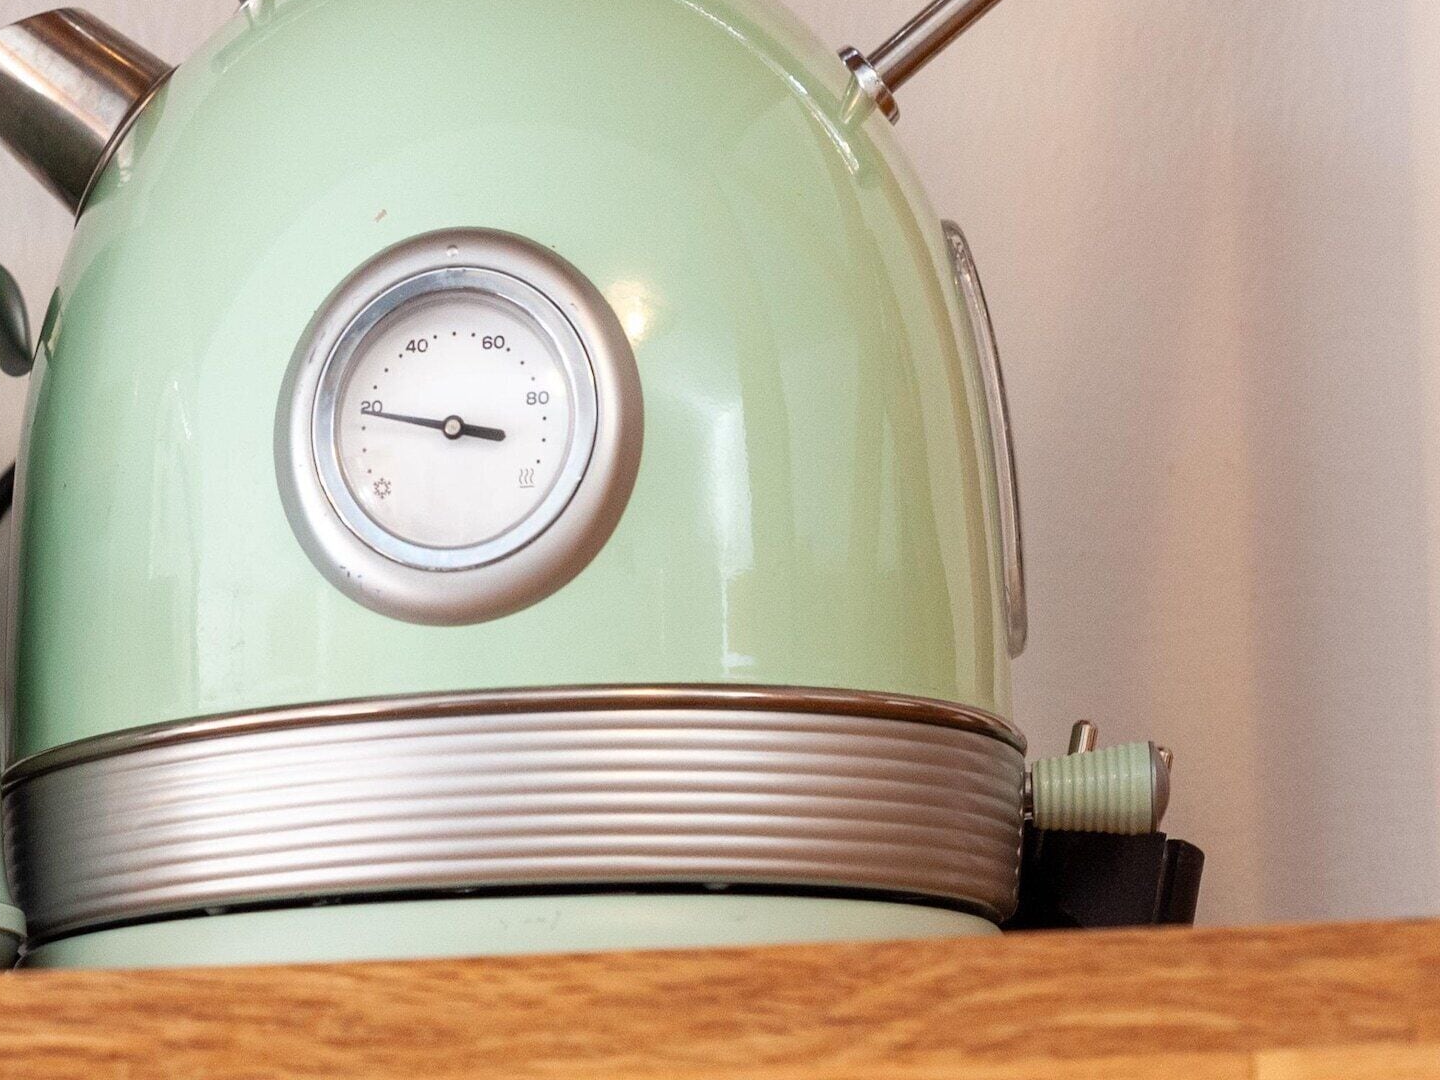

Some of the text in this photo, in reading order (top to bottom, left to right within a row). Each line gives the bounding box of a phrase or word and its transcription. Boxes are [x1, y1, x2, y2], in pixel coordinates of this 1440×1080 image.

[405, 338, 429, 353] 40
[481, 335, 505, 350] 60
[526, 391, 550, 405] 80
[360, 400, 383, 415] 20
